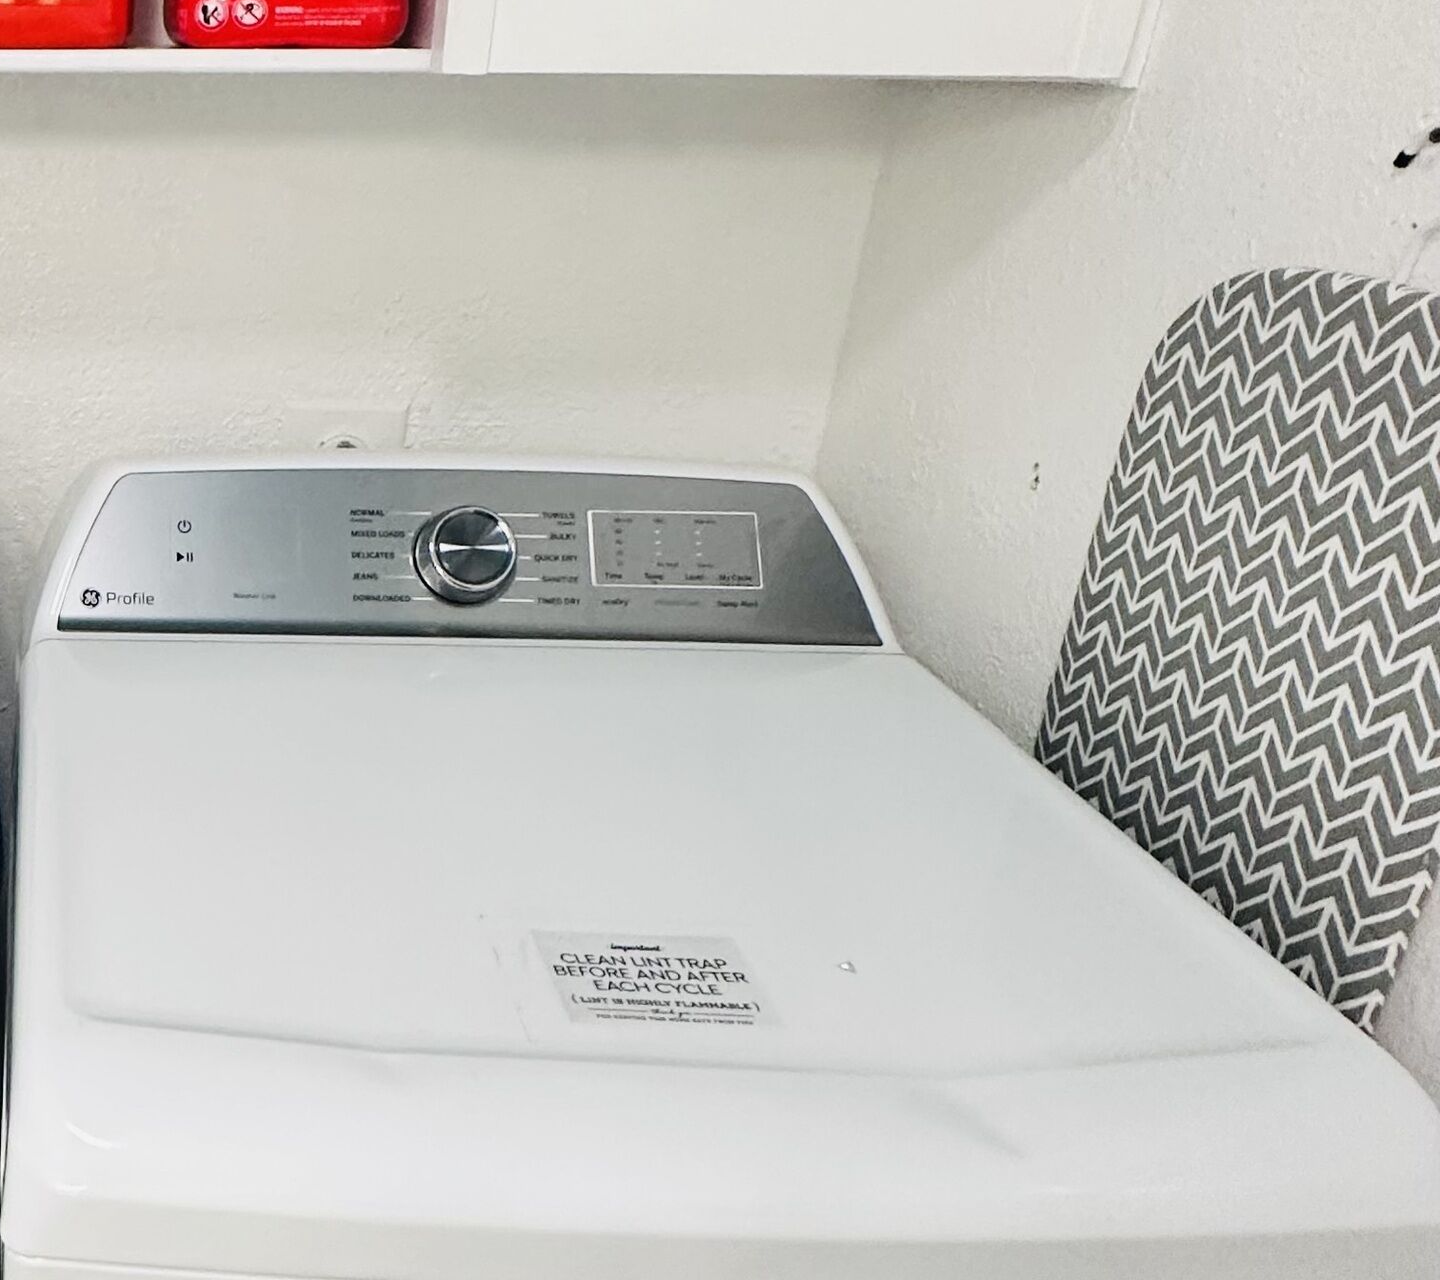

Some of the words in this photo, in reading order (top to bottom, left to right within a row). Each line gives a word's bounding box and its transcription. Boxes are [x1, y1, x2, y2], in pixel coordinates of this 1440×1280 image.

[106, 592, 155, 606] Profile
[560, 953, 626, 966] CLEAN
[630, 956, 670, 968] LINT
[674, 957, 727, 970] TRAP
[553, 964, 632, 979] BEFORE
[637, 969, 681, 981] AND
[687, 970, 749, 984] AFTER
[593, 980, 651, 992] EACH
[654, 983, 723, 996] CYCLE
[625, 998, 671, 1007] HIGHLY
